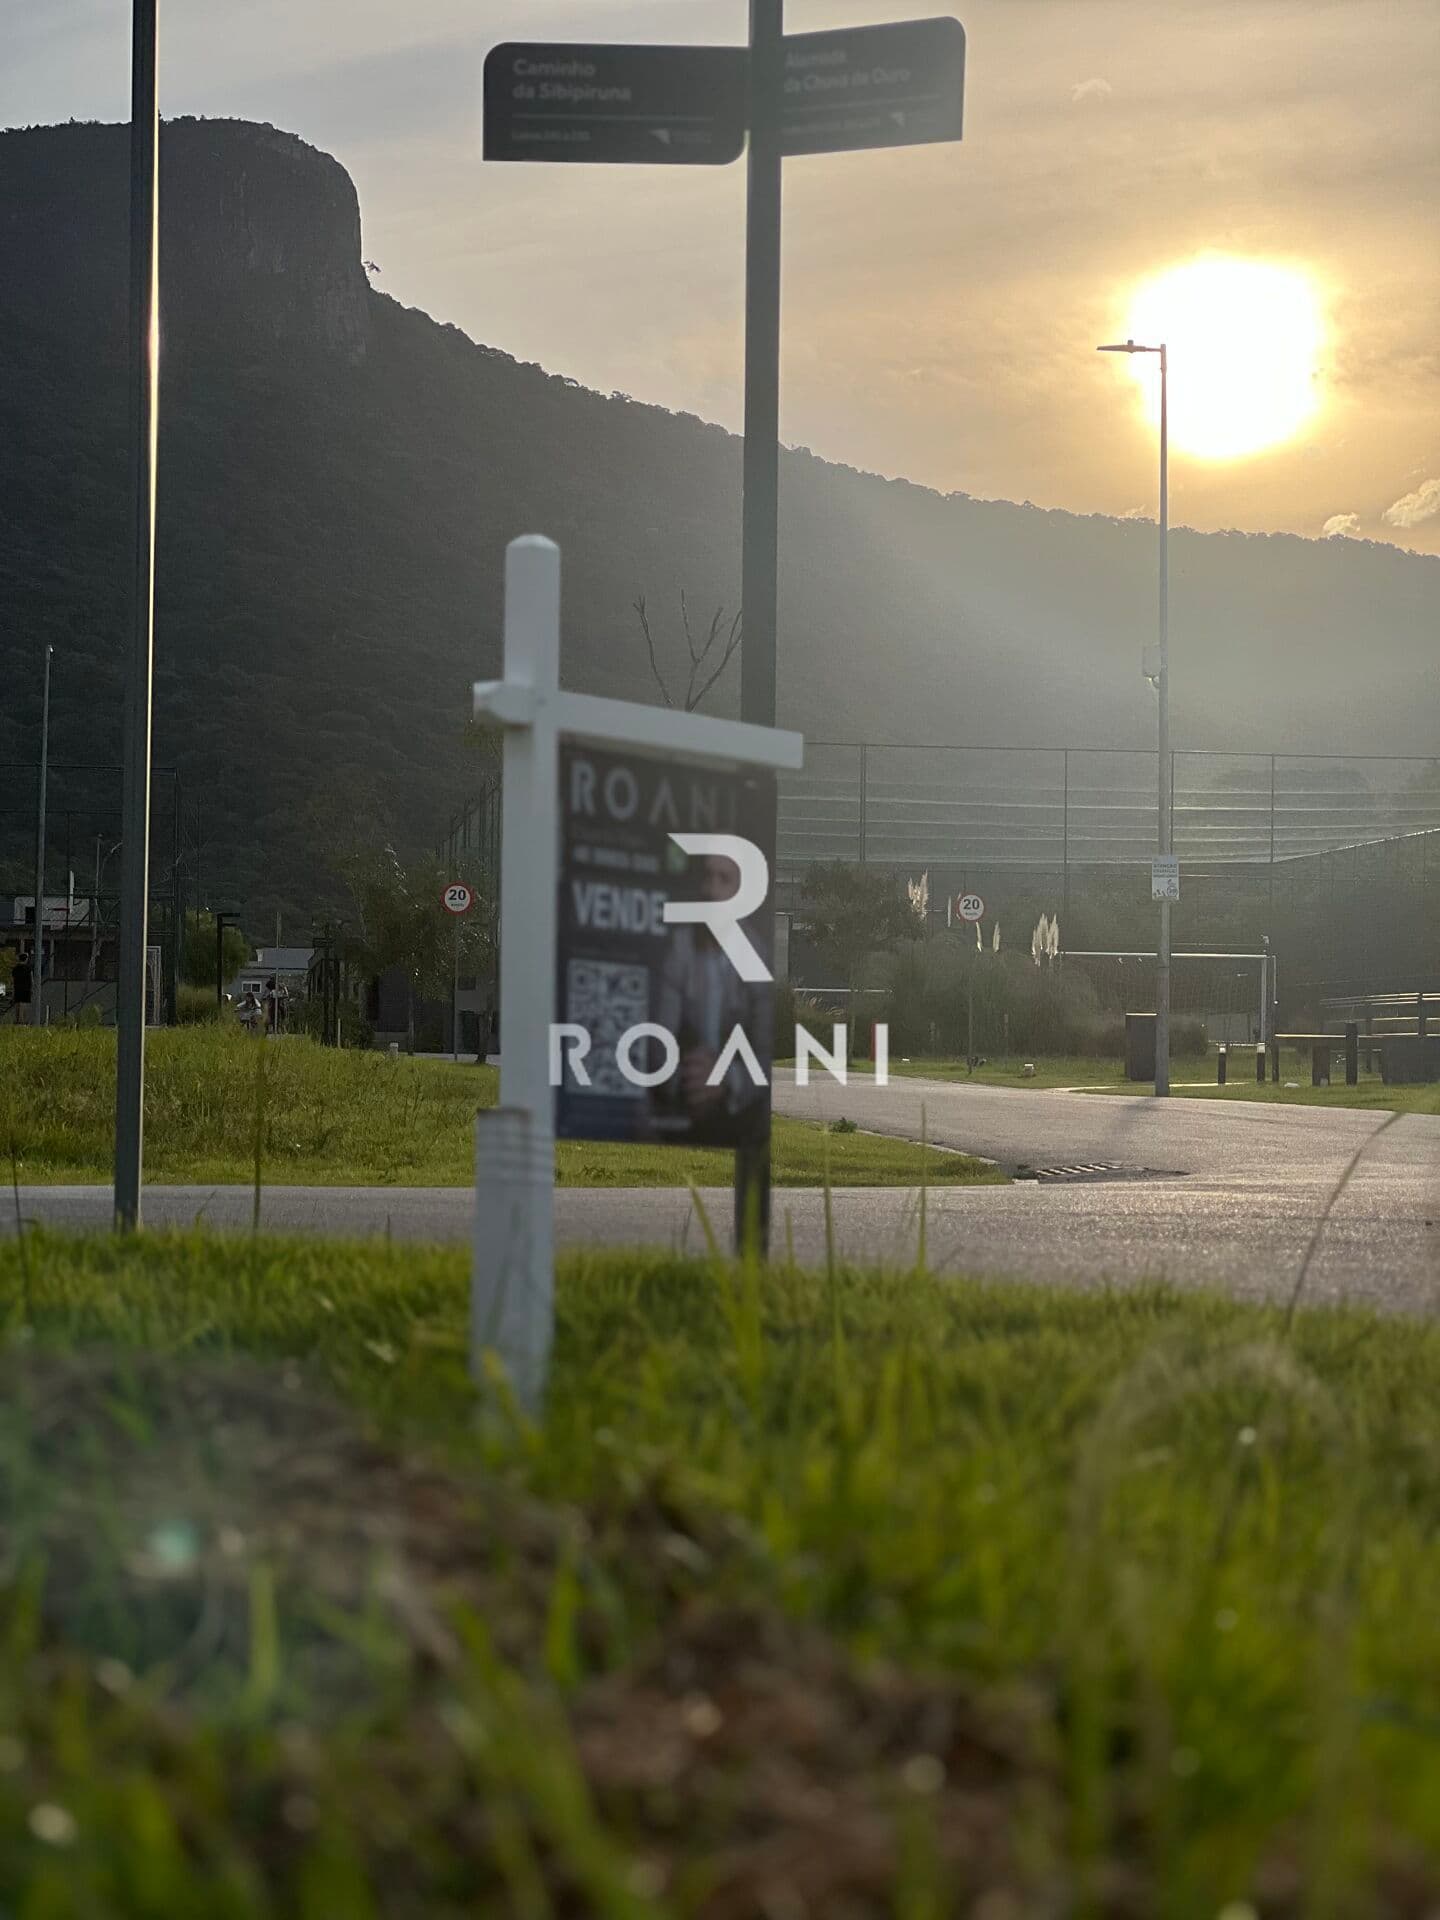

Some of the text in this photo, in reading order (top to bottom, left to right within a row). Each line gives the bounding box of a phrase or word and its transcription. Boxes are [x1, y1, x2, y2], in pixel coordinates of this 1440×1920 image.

[512, 58, 596, 75] Caminho
[871, 66, 912, 84] Ouro
[539, 82, 633, 101] Sibipiruna
[571, 760, 736, 829] ROANI
[449, 889, 466, 900] 20
[963, 898, 979, 909] 20
